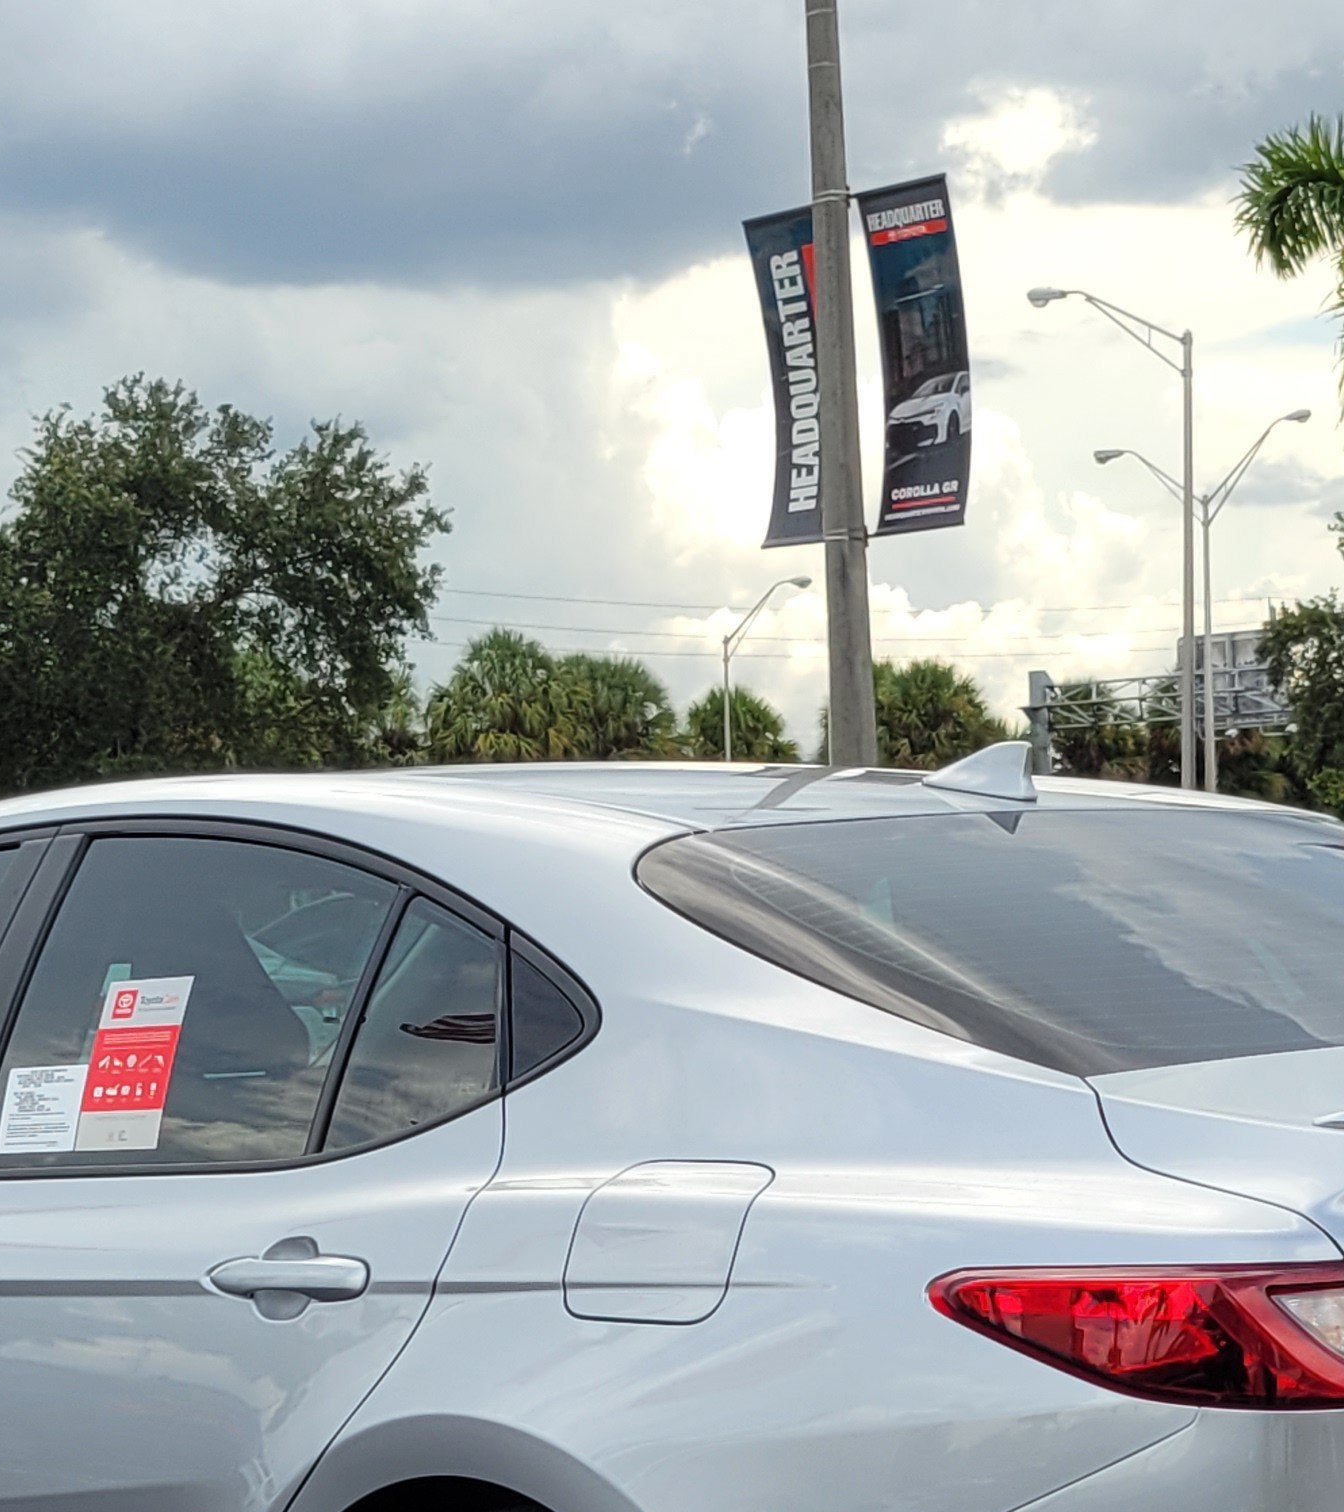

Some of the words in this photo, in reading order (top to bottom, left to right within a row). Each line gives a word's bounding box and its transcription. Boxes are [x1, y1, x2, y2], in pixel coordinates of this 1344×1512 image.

[866, 199, 946, 232] HEADQUARTER
[770, 250, 820, 513] HEADQUARTER
[891, 483, 940, 500] COROLLA
[942, 480, 959, 493] GR
